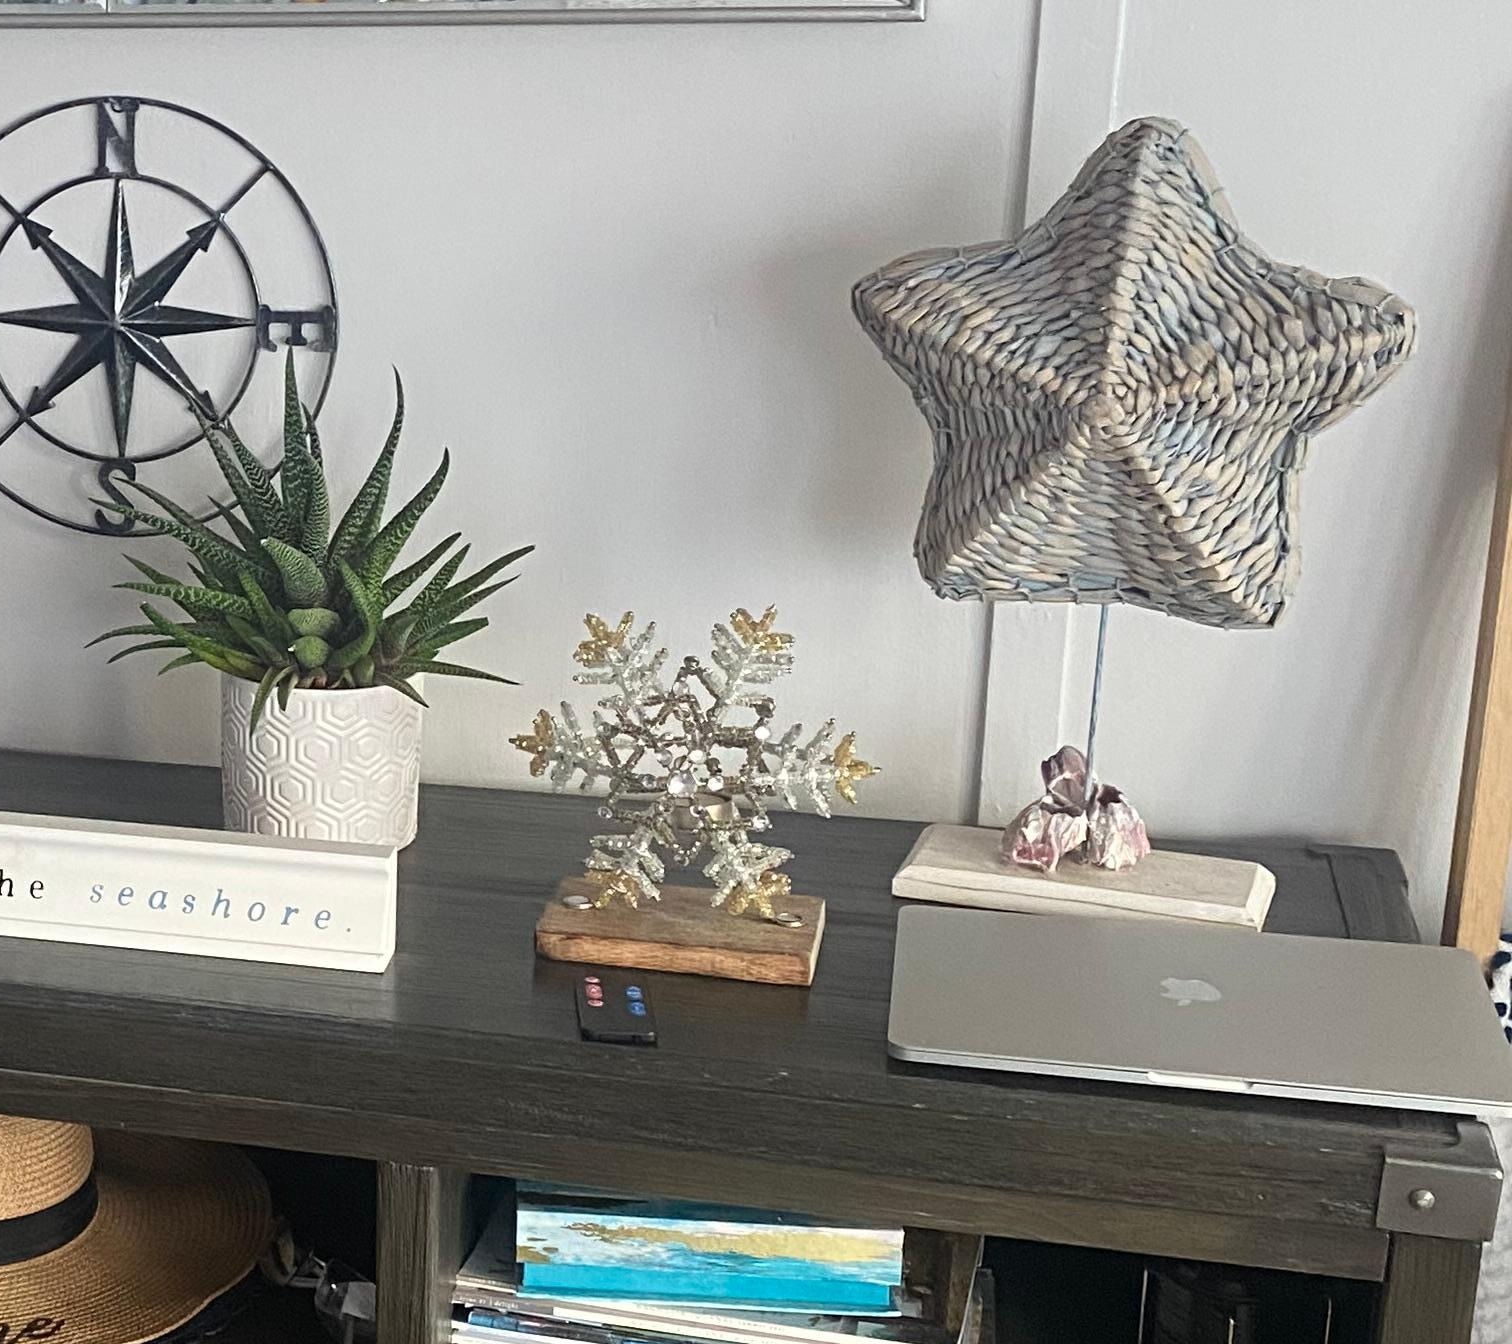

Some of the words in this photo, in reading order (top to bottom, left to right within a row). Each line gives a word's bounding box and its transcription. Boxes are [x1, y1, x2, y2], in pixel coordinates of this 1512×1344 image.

[94, 98, 140, 177] N
[258, 303, 336, 354] E
[94, 459, 137, 532] S
[89, 883, 352, 934] seashore.
